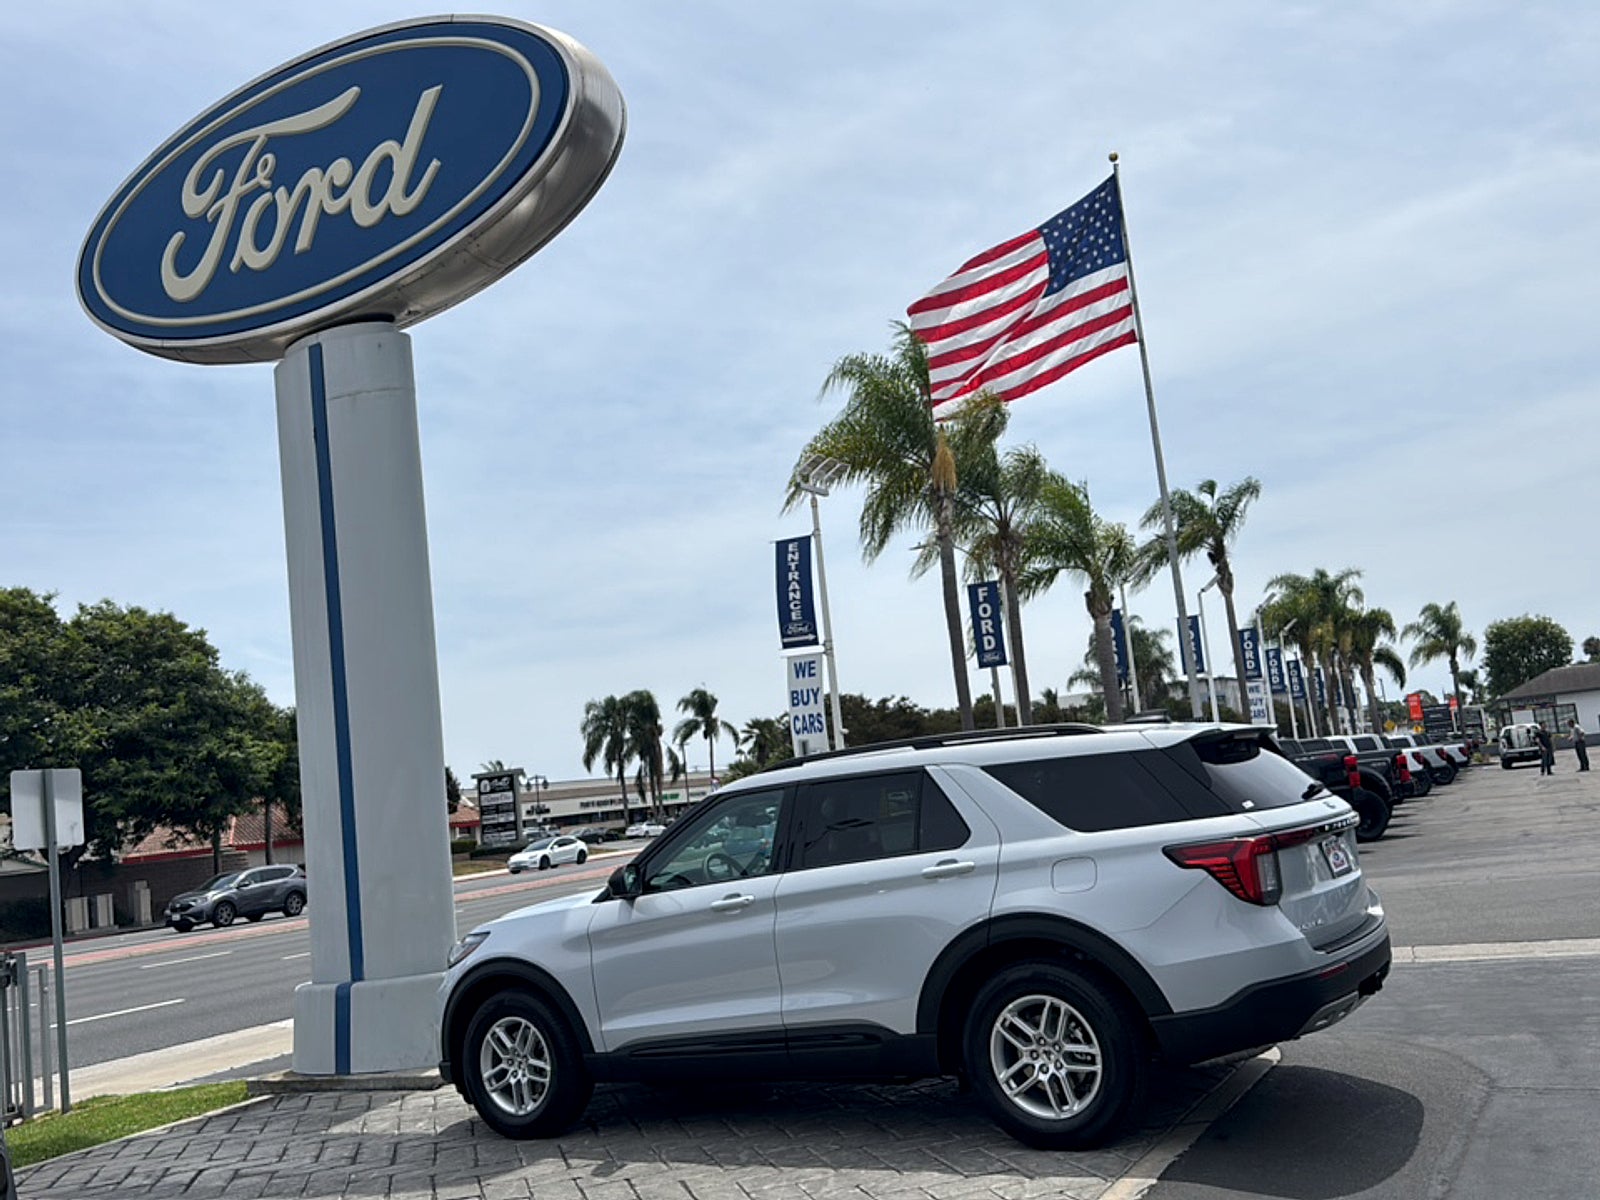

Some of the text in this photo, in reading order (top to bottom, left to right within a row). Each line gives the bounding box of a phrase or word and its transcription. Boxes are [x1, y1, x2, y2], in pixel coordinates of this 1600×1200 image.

[160, 84, 444, 301] Ford
[787, 542, 803, 621] ENTRANCE
[978, 586, 996, 651] FORD
[1243, 631, 1256, 669] FORD
[1269, 650, 1280, 683] FORD
[794, 660, 816, 679] WE
[1289, 661, 1300, 691] FORD
[791, 687, 820, 707] BUY
[793, 713, 824, 735] CARS
